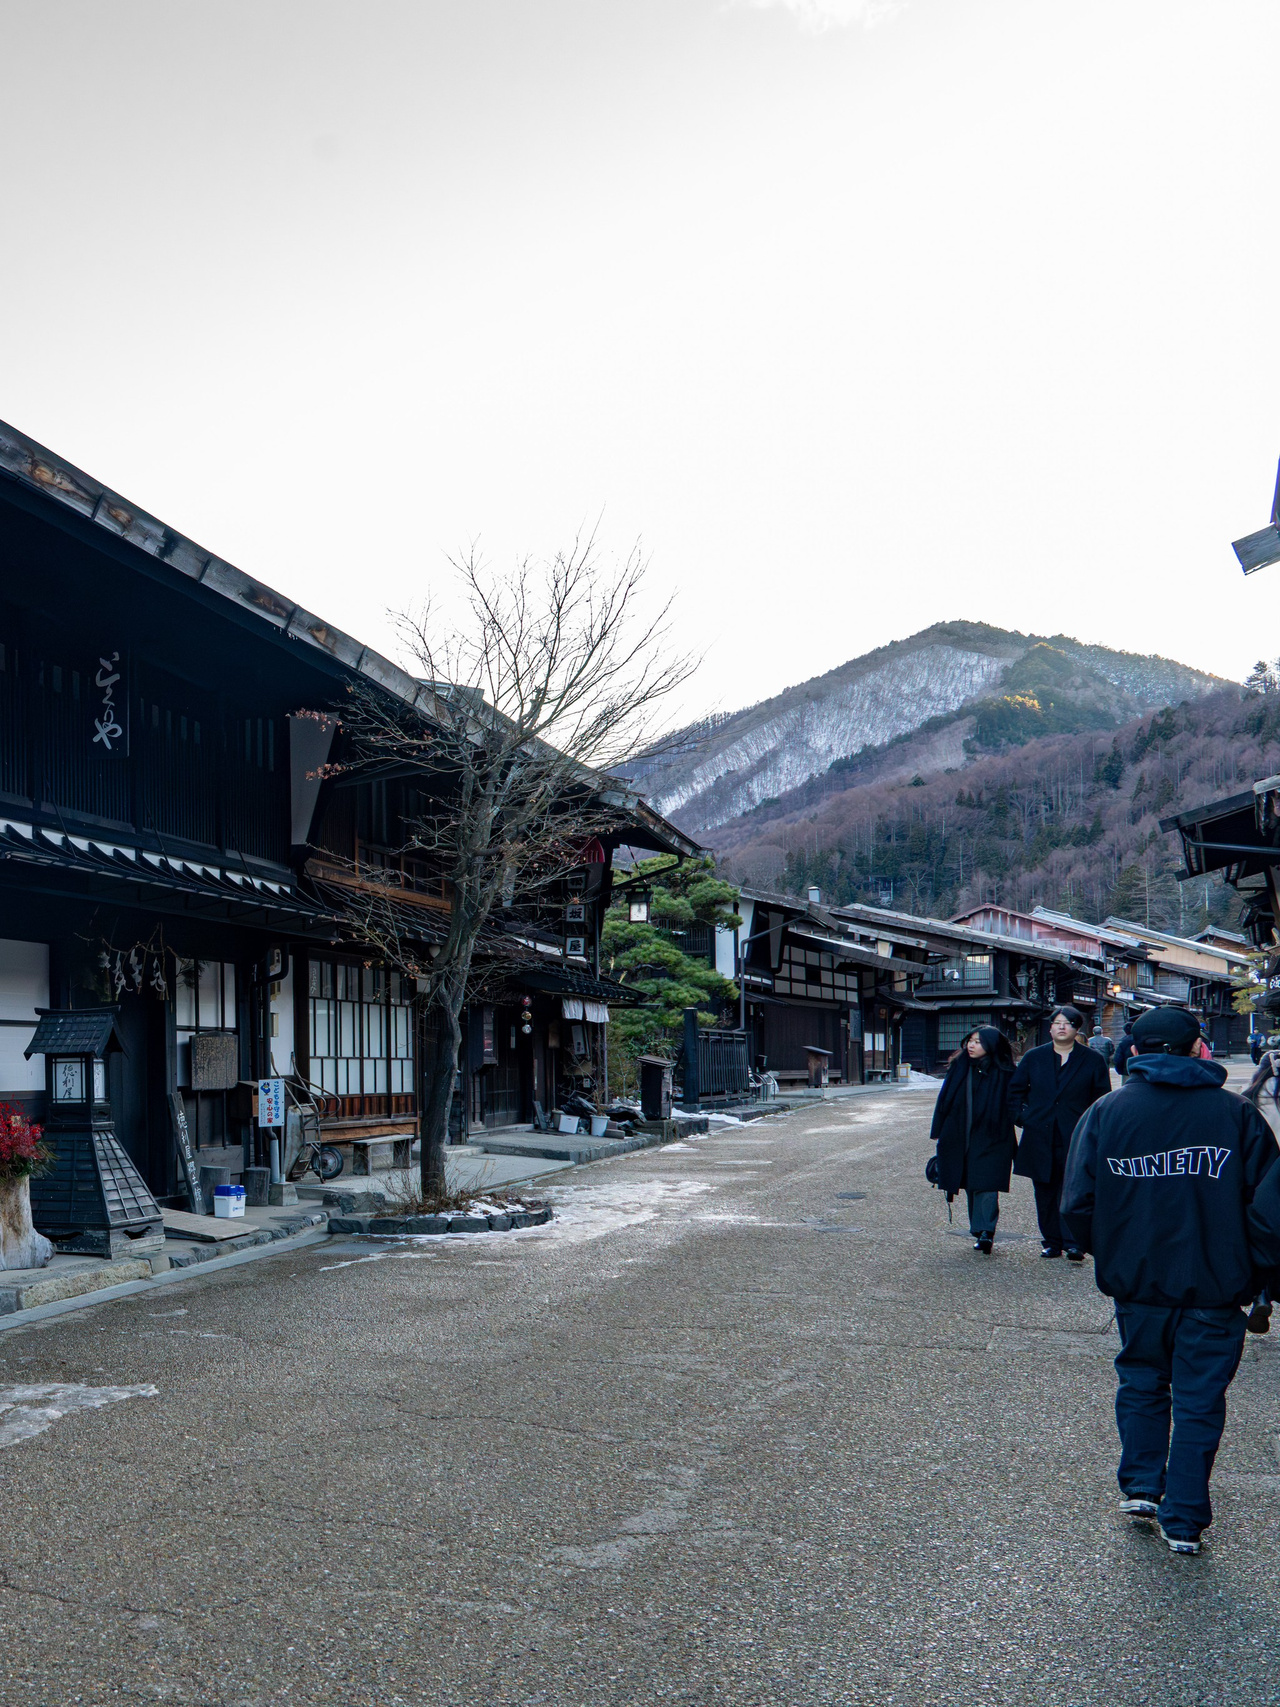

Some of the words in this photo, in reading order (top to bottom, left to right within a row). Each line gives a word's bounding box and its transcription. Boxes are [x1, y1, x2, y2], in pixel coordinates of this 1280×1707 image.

[62, 1064, 78, 1099] 徳利屋
[1106, 1145, 1232, 1179] NINETY
